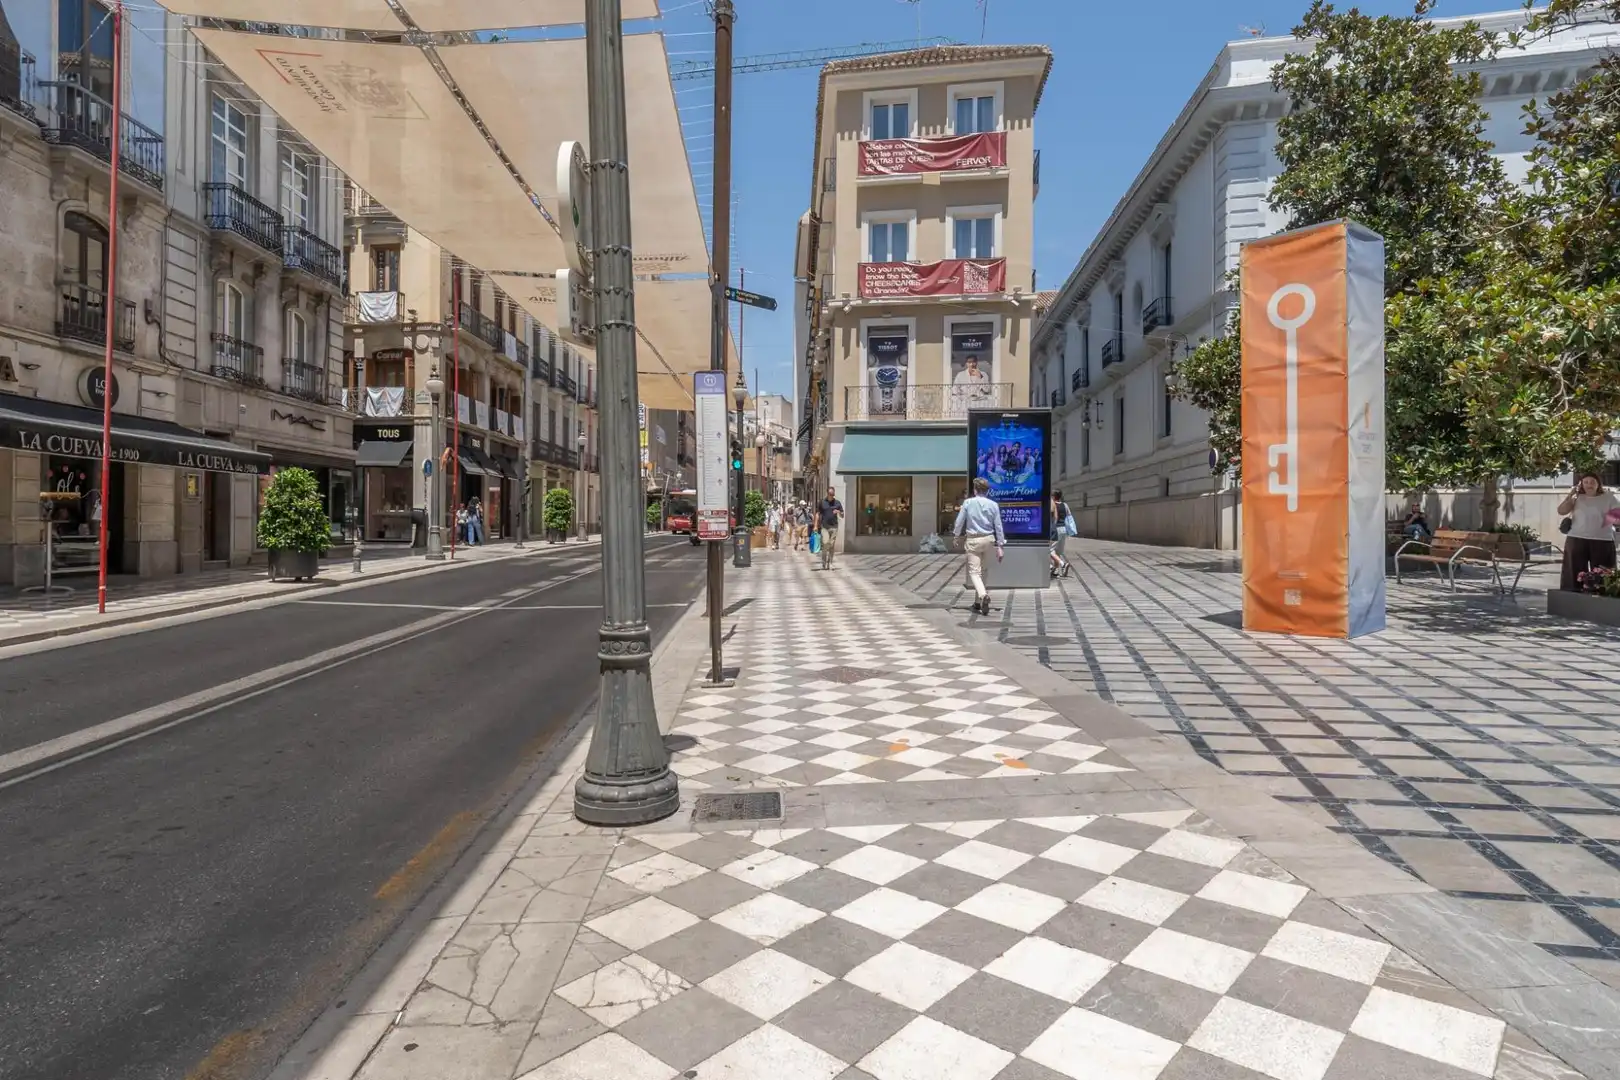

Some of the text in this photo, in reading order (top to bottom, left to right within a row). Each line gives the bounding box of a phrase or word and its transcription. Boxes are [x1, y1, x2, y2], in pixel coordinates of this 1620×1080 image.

[956, 155, 992, 166] FERVOR
[377, 429, 400, 438] TOUS
[19, 431, 42, 450] LA
[46, 434, 103, 457] CUEVA
[119, 448, 140, 460] 1900
[178, 452, 195, 466] LA
[196, 455, 234, 471] CUEVA
